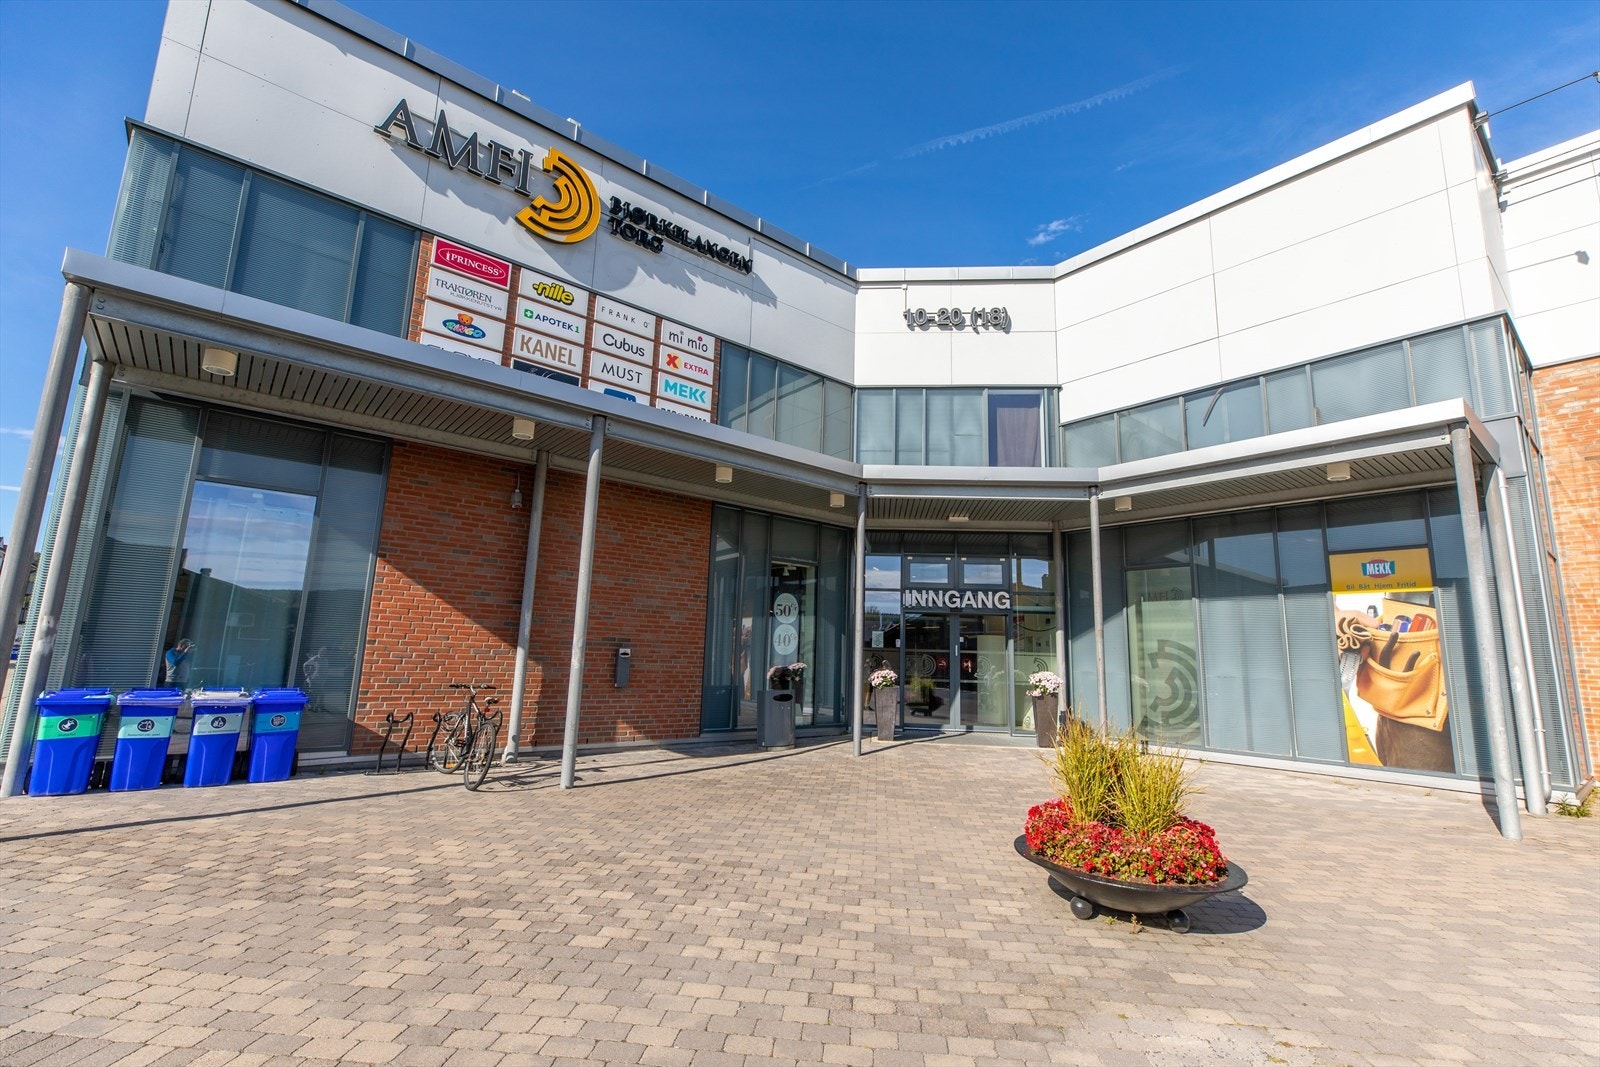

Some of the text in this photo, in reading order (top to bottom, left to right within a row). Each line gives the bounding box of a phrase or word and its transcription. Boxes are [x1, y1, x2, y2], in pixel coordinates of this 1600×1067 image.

[374, 98, 533, 197] AMFI
[607, 216, 664, 255] TORG
[435, 278, 492, 303] TRAKTØREN
[534, 313, 573, 332] APOTEK
[601, 306, 636, 323] FRANK
[903, 307, 1008, 328] 10-20 (18)
[520, 334, 577, 367] KANEL
[602, 333, 645, 357] Cubus
[668, 330, 708, 353] mi mio
[601, 362, 643, 384] MUST
[683, 362, 709, 376] EXTRA
[1366, 561, 1392, 575] MEKK
[904, 589, 1011, 609] INNGANG
